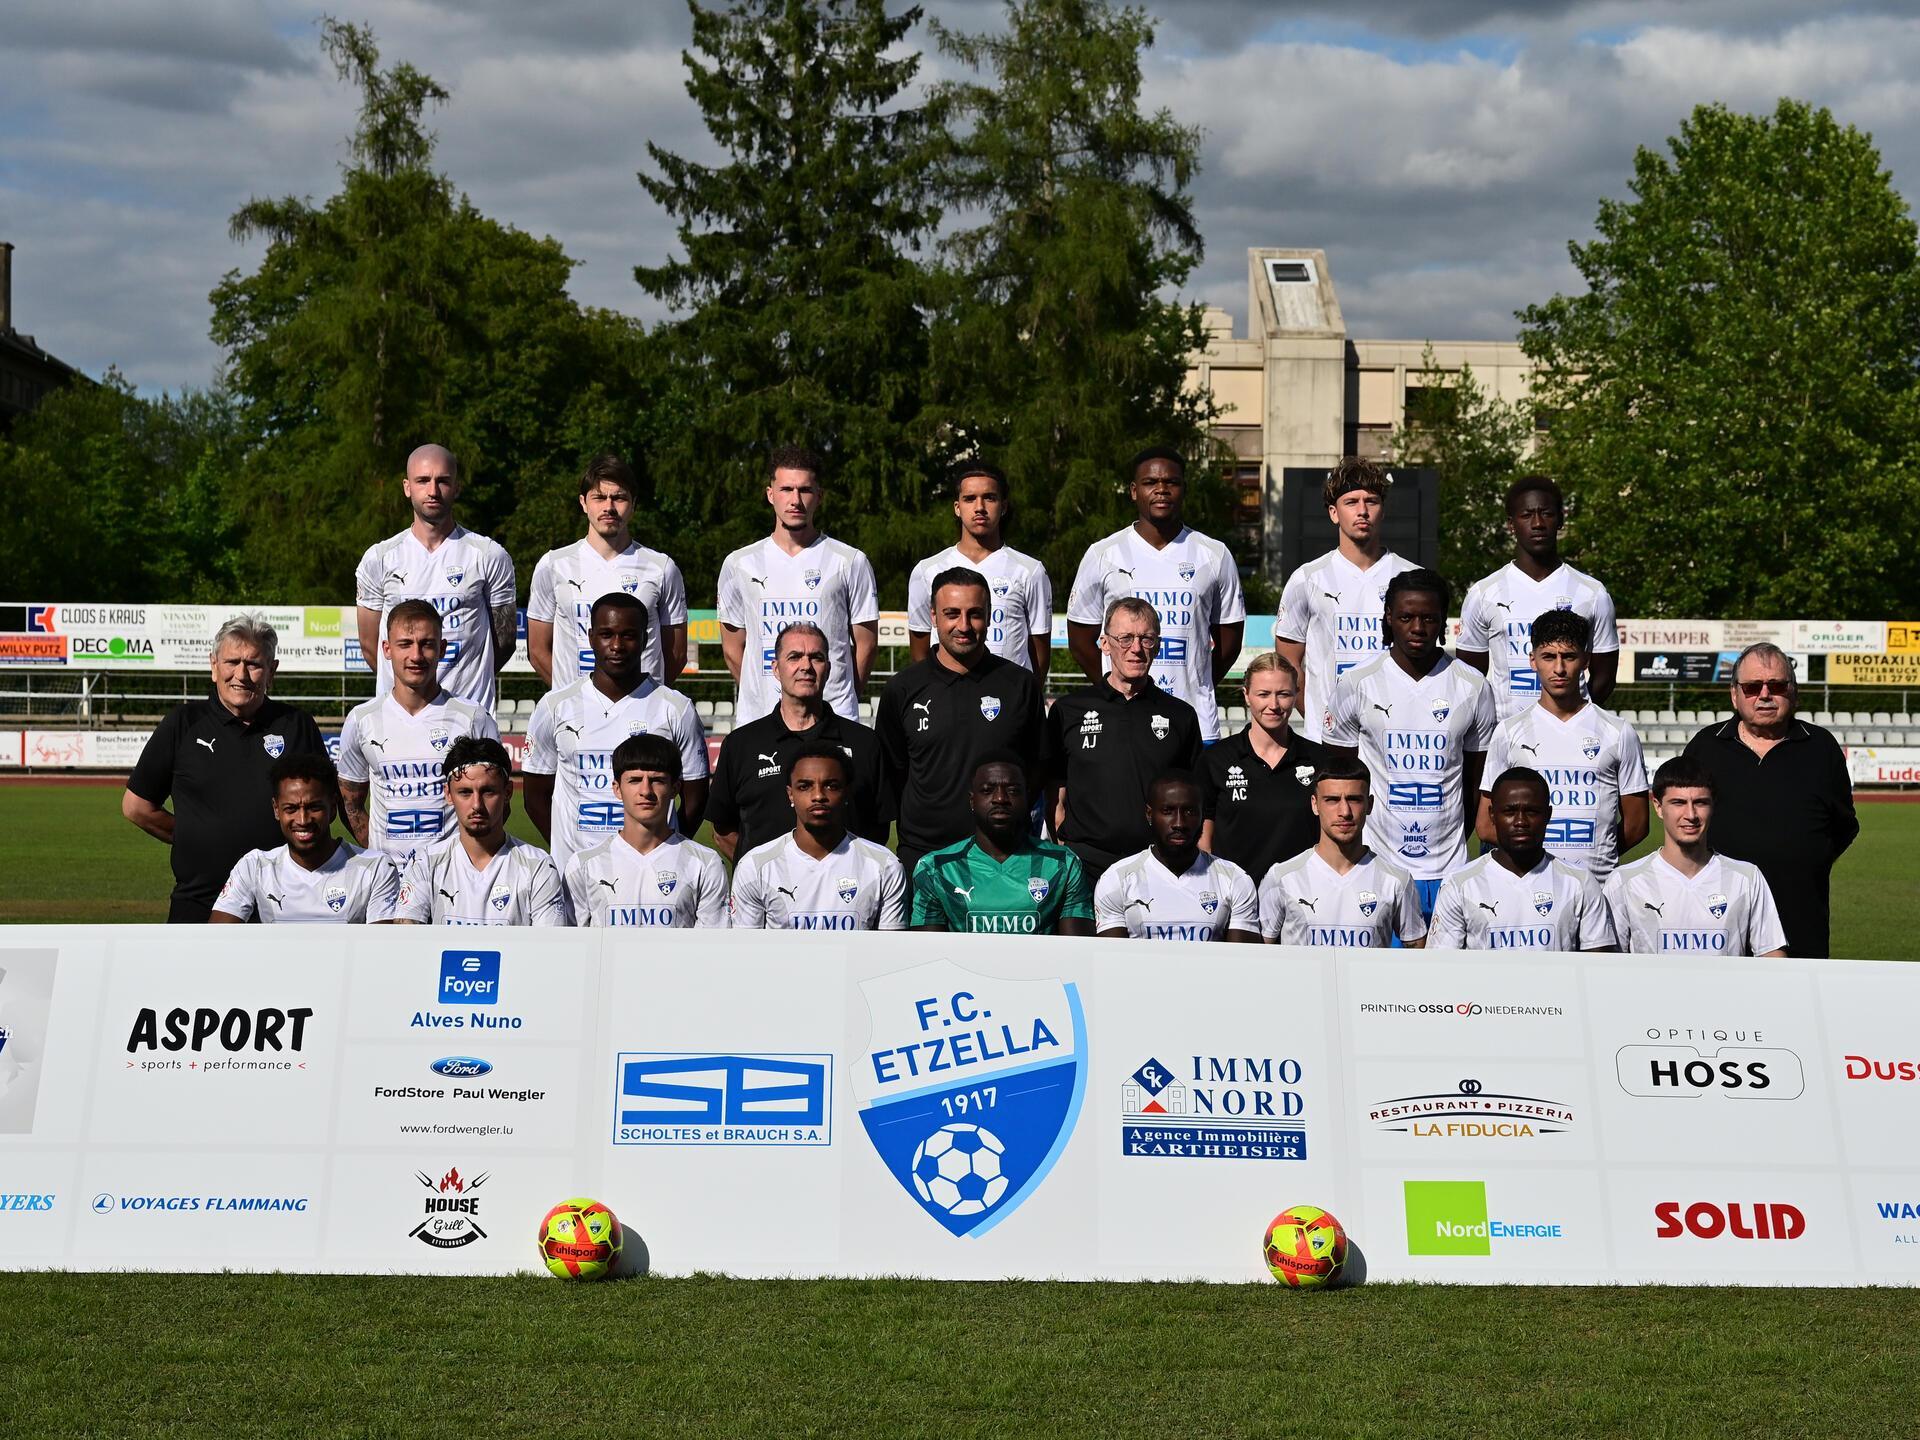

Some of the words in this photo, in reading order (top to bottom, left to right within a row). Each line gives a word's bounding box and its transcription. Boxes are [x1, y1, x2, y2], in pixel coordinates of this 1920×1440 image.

[62, 608, 96, 624] CLOOS
[109, 609, 146, 624] KRAUS
[763, 602, 818, 617] IMMO
[1339, 617, 1378, 632] IMM
[1508, 623, 1532, 637] IM
[1629, 632, 1710, 645] STEMPER
[0, 644, 31, 654] WILLY
[34, 644, 61, 654] PUTZ
[277, 645, 312, 658] burger
[1836, 655, 1904, 665] EUROTAXI
[1876, 674, 1887, 682] 81
[1890, 674, 1902, 682] 27
[1905, 674, 1917, 682] 97
[917, 718, 928, 731] JC
[1080, 724, 1102, 733] ASPORT
[96, 735, 139, 743] Boucherie
[1082, 735, 1097, 749] AJ
[1387, 733, 1446, 750] IMMO
[579, 754, 613, 770] IM
[1388, 754, 1446, 770] NORD
[383, 762, 444, 780] IMMO
[758, 765, 781, 776] ASPORT
[1542, 770, 1596, 786] MMO
[387, 782, 444, 798] NORD
[1225, 779, 1248, 787] ASPORT
[1232, 787, 1247, 801] AC
[1551, 790, 1596, 806] ORD
[1403, 834, 1428, 844] HOUSE
[611, 908, 673, 926] IMMO
[794, 915, 855, 931] IMMO
[971, 915, 1037, 933] IMMO
[1146, 925, 1212, 941] IMMO
[1310, 929, 1371, 947] IMMO
[1490, 928, 1551, 949] IMMO
[1662, 933, 1725, 950] IMMO
[444, 976, 494, 997] Foyer
[915, 991, 991, 1031] F.C.
[1360, 1003, 1416, 1013] PRINTING
[1485, 1005, 1562, 1016] NIEDERANVEN
[411, 1012, 464, 1028] Alves
[471, 1013, 522, 1029] Nuno
[127, 1007, 313, 1053] ASPORT
[1646, 1028, 1764, 1042] OPTIQUE
[871, 1018, 1059, 1084] ETZELLA
[141, 1060, 182, 1072] sports
[204, 1058, 292, 1072] performance
[442, 1058, 480, 1075] Ford
[1192, 1056, 1302, 1084] IMMO
[1845, 1055, 1920, 1081] Dus
[1650, 1060, 1770, 1089] HOSS
[374, 1087, 444, 1099] FordStore
[453, 1087, 485, 1099] Paul
[488, 1088, 546, 1102] Wengler
[941, 1087, 998, 1117] 1917
[1193, 1088, 1304, 1116] NORD
[1370, 1101, 1478, 1120] RESTAURANT
[1498, 1102, 1574, 1121] PIZZERIA
[400, 1124, 514, 1136] www.fordwengler.lu
[620, 1128, 701, 1140] SCHOLTES
[705, 1129, 719, 1140] et
[724, 1129, 789, 1141] BRAUCH
[793, 1129, 823, 1141] S.A.
[1131, 1129, 1191, 1142] Agence
[1197, 1130, 1300, 1144] Immobilière
[1413, 1123, 1443, 1137] LA
[1447, 1123, 1534, 1137] FIDUCIA
[1131, 1143, 1299, 1158] KARTHEISER
[121, 1197, 200, 1210] VOYAGES
[205, 1197, 308, 1211] FLAMMANG
[425, 1198, 479, 1215] HOUSE
[433, 1218, 464, 1234] Grill
[1655, 1202, 1805, 1240] SOLID
[556, 1245, 599, 1257] uhlsport
[1276, 1255, 1320, 1271] uhlsport
